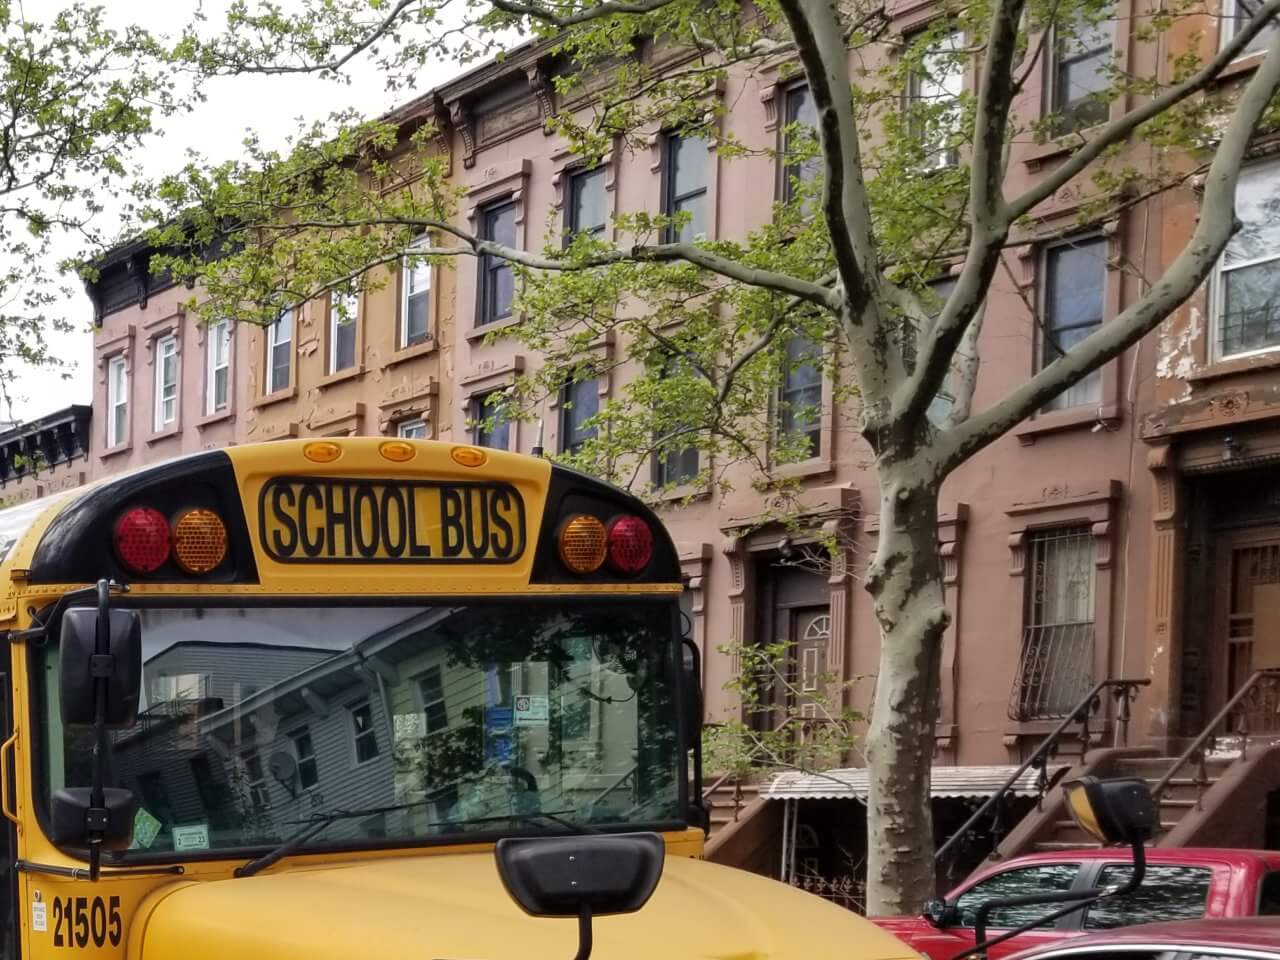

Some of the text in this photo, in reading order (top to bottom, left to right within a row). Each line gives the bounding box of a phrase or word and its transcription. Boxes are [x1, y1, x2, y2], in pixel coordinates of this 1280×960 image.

[272, 483, 513, 558] SCHOOL BUS
[53, 896, 122, 948] 21505
